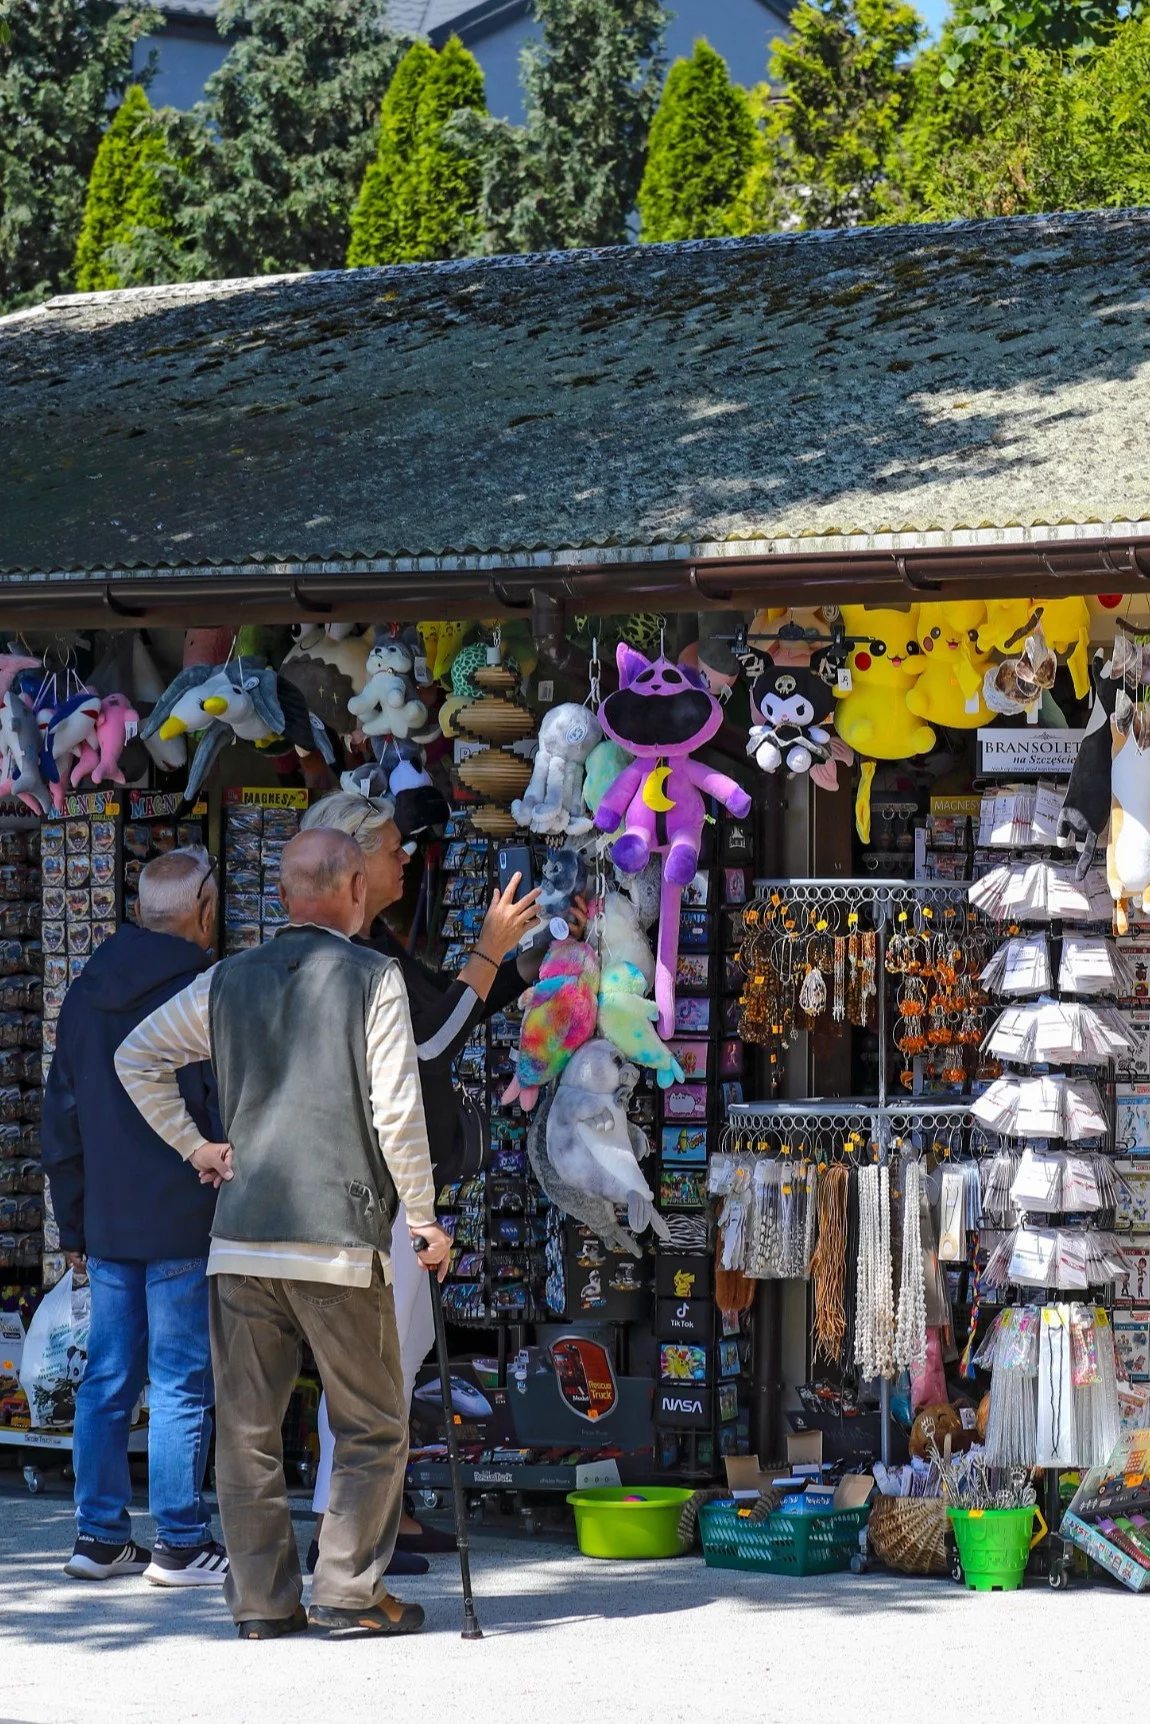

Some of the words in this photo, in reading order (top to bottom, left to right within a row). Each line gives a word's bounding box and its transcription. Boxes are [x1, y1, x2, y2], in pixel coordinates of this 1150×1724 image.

[985, 741, 1083, 754] BRANSOLET
[1029, 754, 1077, 766] Szczęście
[934, 801, 980, 811] MAGNESY
[670, 1319, 694, 1329] TikTok
[590, 1389, 612, 1400] Truck
[662, 1397, 702, 1413] NASA
